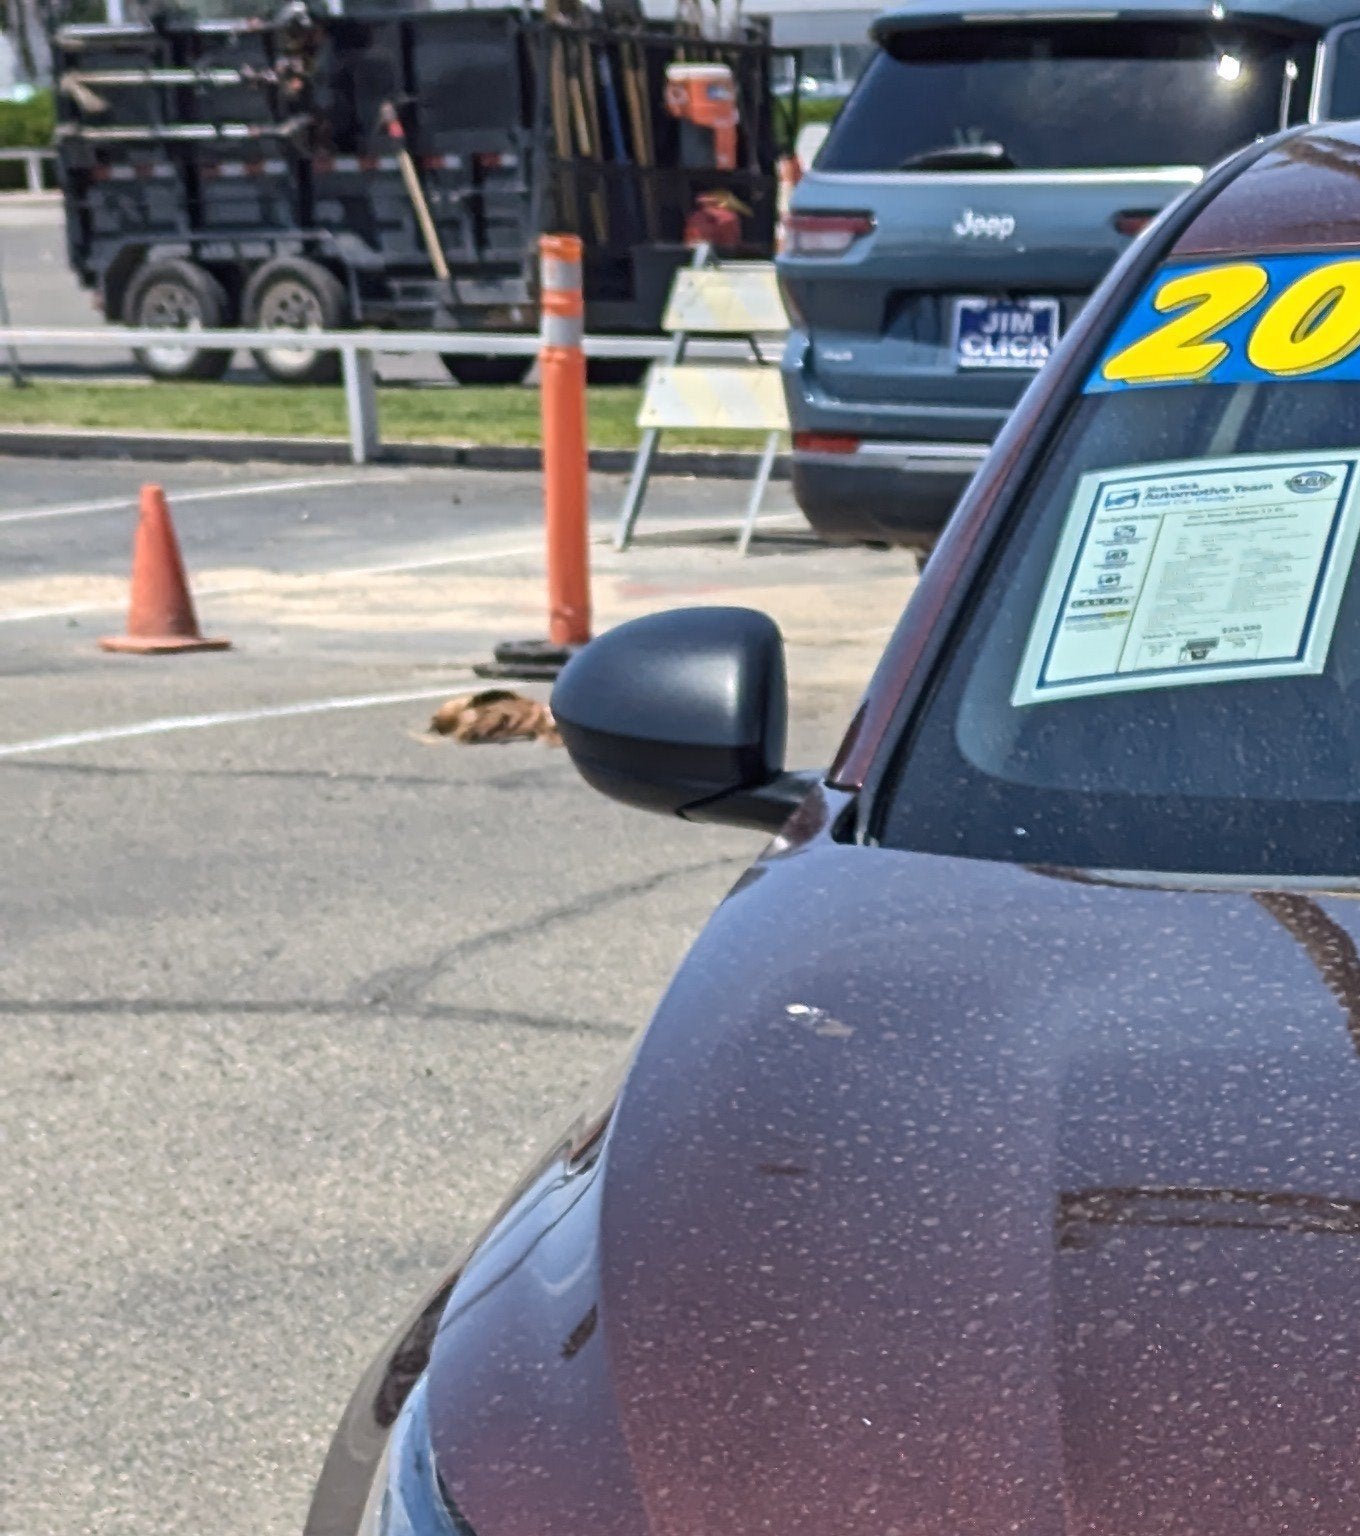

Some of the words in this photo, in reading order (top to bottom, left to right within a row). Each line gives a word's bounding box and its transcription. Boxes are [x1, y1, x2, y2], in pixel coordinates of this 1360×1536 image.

[953, 208, 1016, 240] Jeep
[982, 312, 1035, 335] JIM
[960, 334, 1050, 358] CLICK
[1145, 486, 1230, 500] Automotive
[1233, 483, 1274, 494] Team
